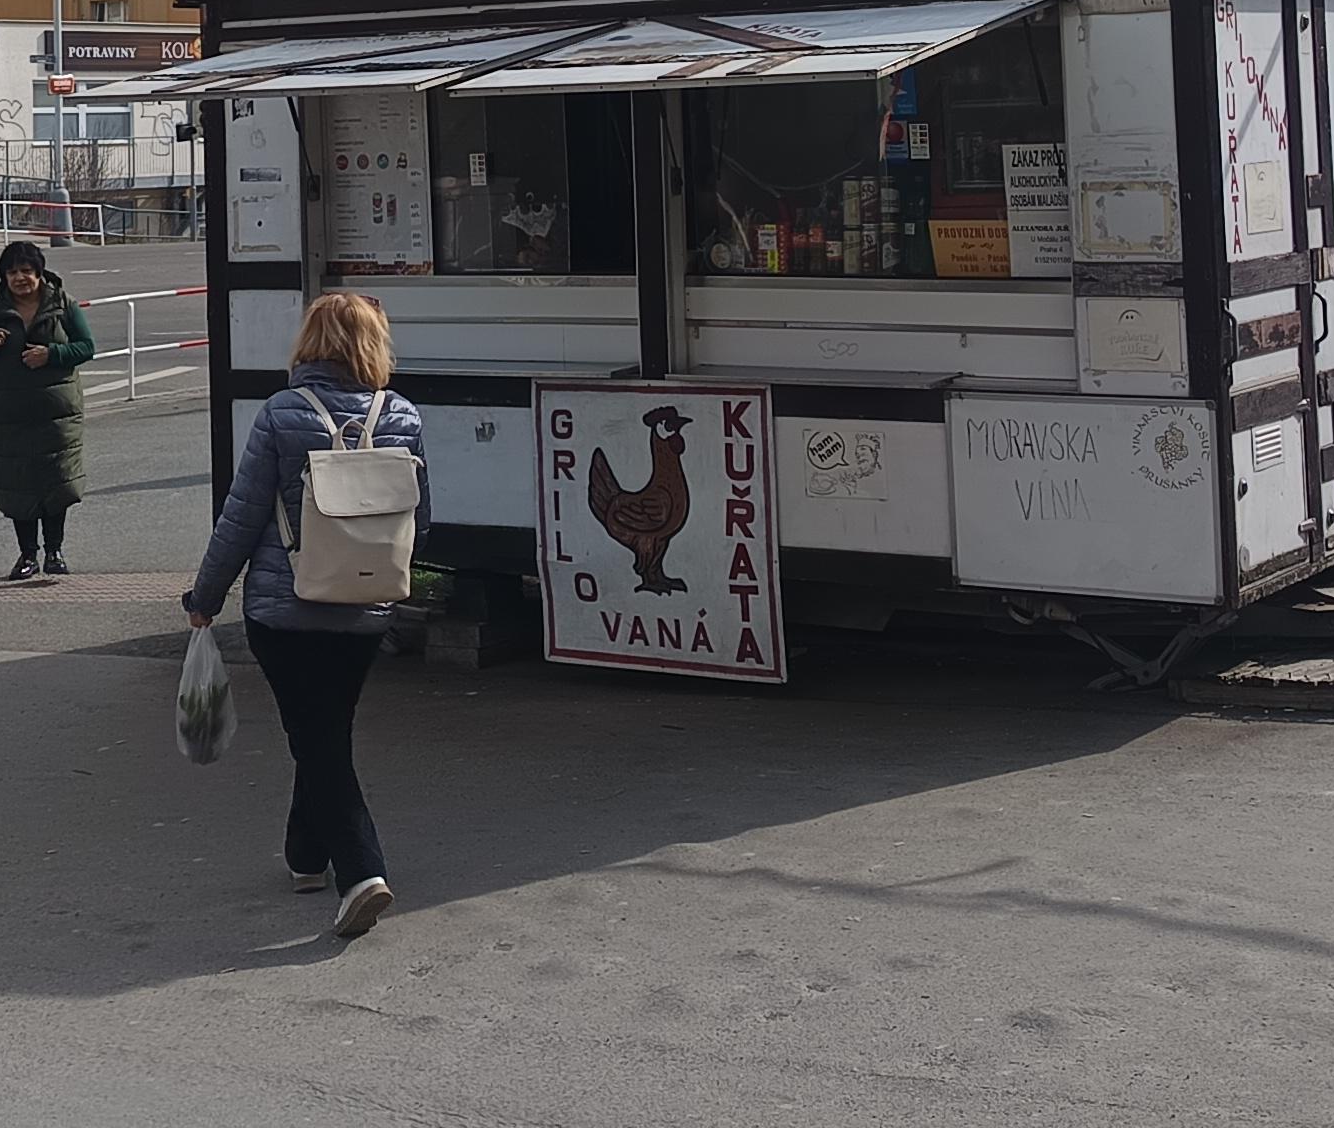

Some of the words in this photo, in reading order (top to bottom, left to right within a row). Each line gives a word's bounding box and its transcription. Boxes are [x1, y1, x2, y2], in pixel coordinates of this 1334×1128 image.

[68, 46, 137, 59] POTRAVINY
[1011, 147, 1040, 168] ZÁKAZ
[1225, 61, 1243, 254] KUŘATA
[1010, 192, 1036, 207] OSOBÁM
[937, 225, 986, 239] PROVOZNÍ
[809, 435, 834, 457] ham
[967, 417, 1101, 464] MORAVSKÁ
[817, 441, 842, 463] ham
[722, 401, 765, 665] KUŘATA
